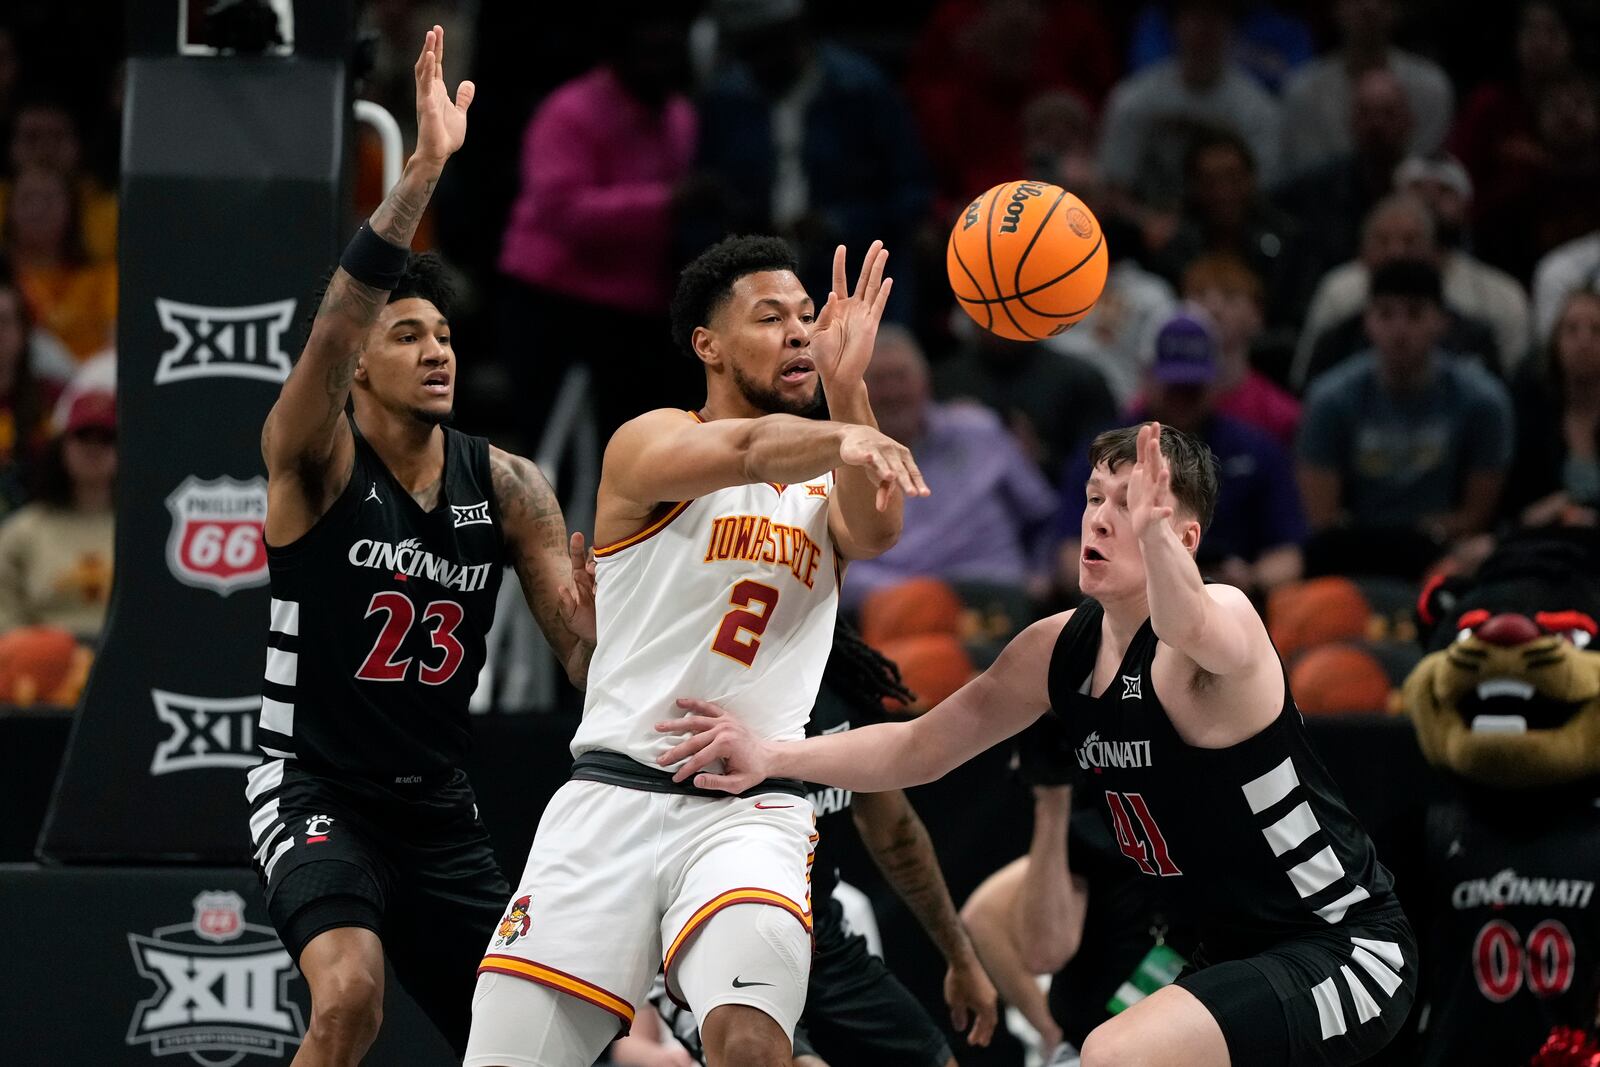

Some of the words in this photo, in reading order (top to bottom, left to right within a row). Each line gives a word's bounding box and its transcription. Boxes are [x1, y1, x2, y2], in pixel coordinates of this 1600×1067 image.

[162, 306, 289, 375] XII
[188, 496, 263, 513] PHILLIPS
[453, 503, 490, 526] XII
[804, 484, 828, 498] XII
[190, 525, 259, 568] 66
[348, 538, 492, 592] CINCINNATI
[703, 515, 770, 564] IOWA
[354, 590, 464, 685] 23
[710, 578, 779, 670] 2
[1105, 790, 1183, 877] 41
[1451, 868, 1594, 909] CINCINNATI
[1472, 919, 1575, 1003] 00
[142, 949, 294, 1031] XII
